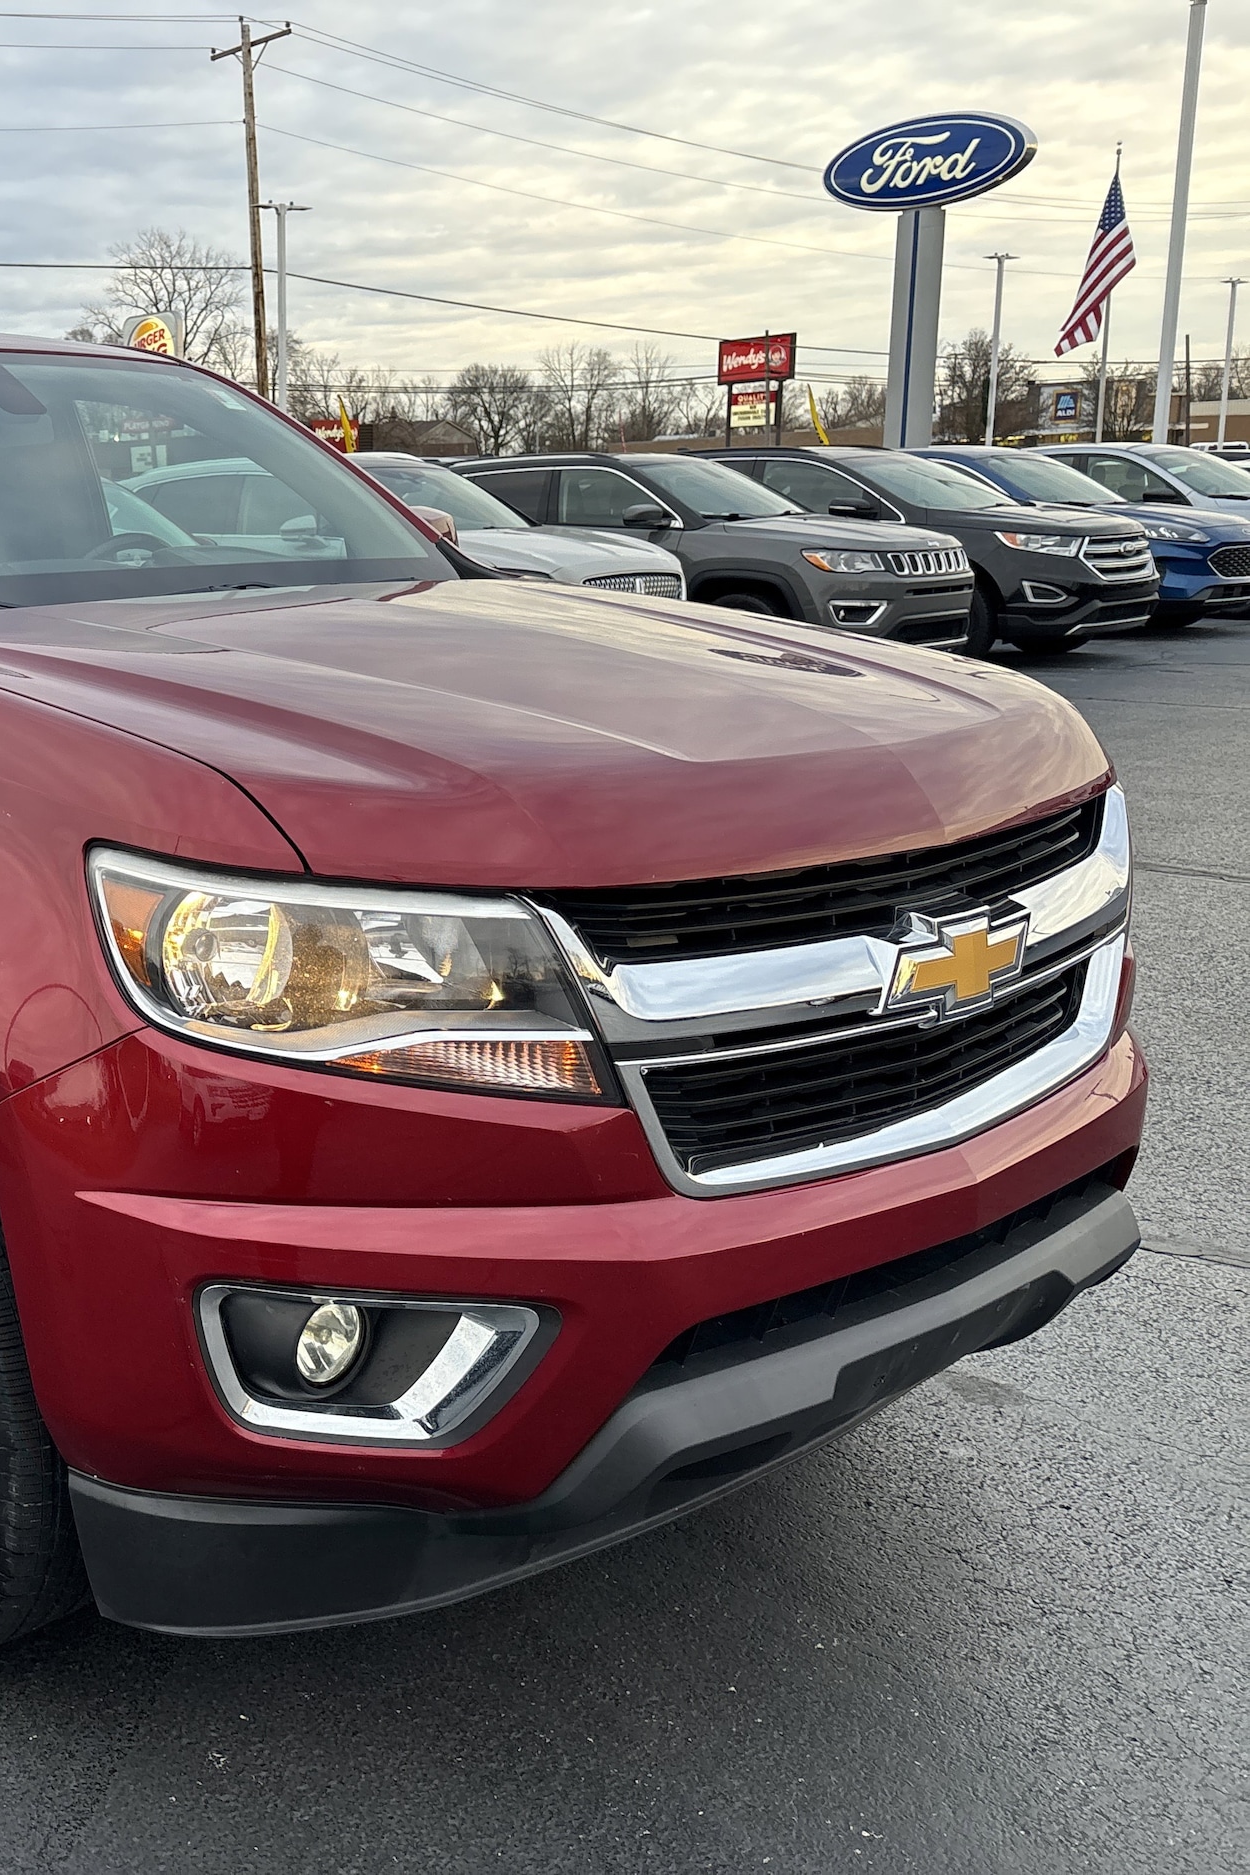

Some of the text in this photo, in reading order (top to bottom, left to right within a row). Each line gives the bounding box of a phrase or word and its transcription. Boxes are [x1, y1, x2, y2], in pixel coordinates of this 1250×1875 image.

[860, 130, 981, 194] Ford
[722, 347, 766, 373] Wendy's
[737, 393, 767, 403] QUALIT
[1056, 409, 1076, 417] ALDI
[315, 424, 345, 443] Wendy's
